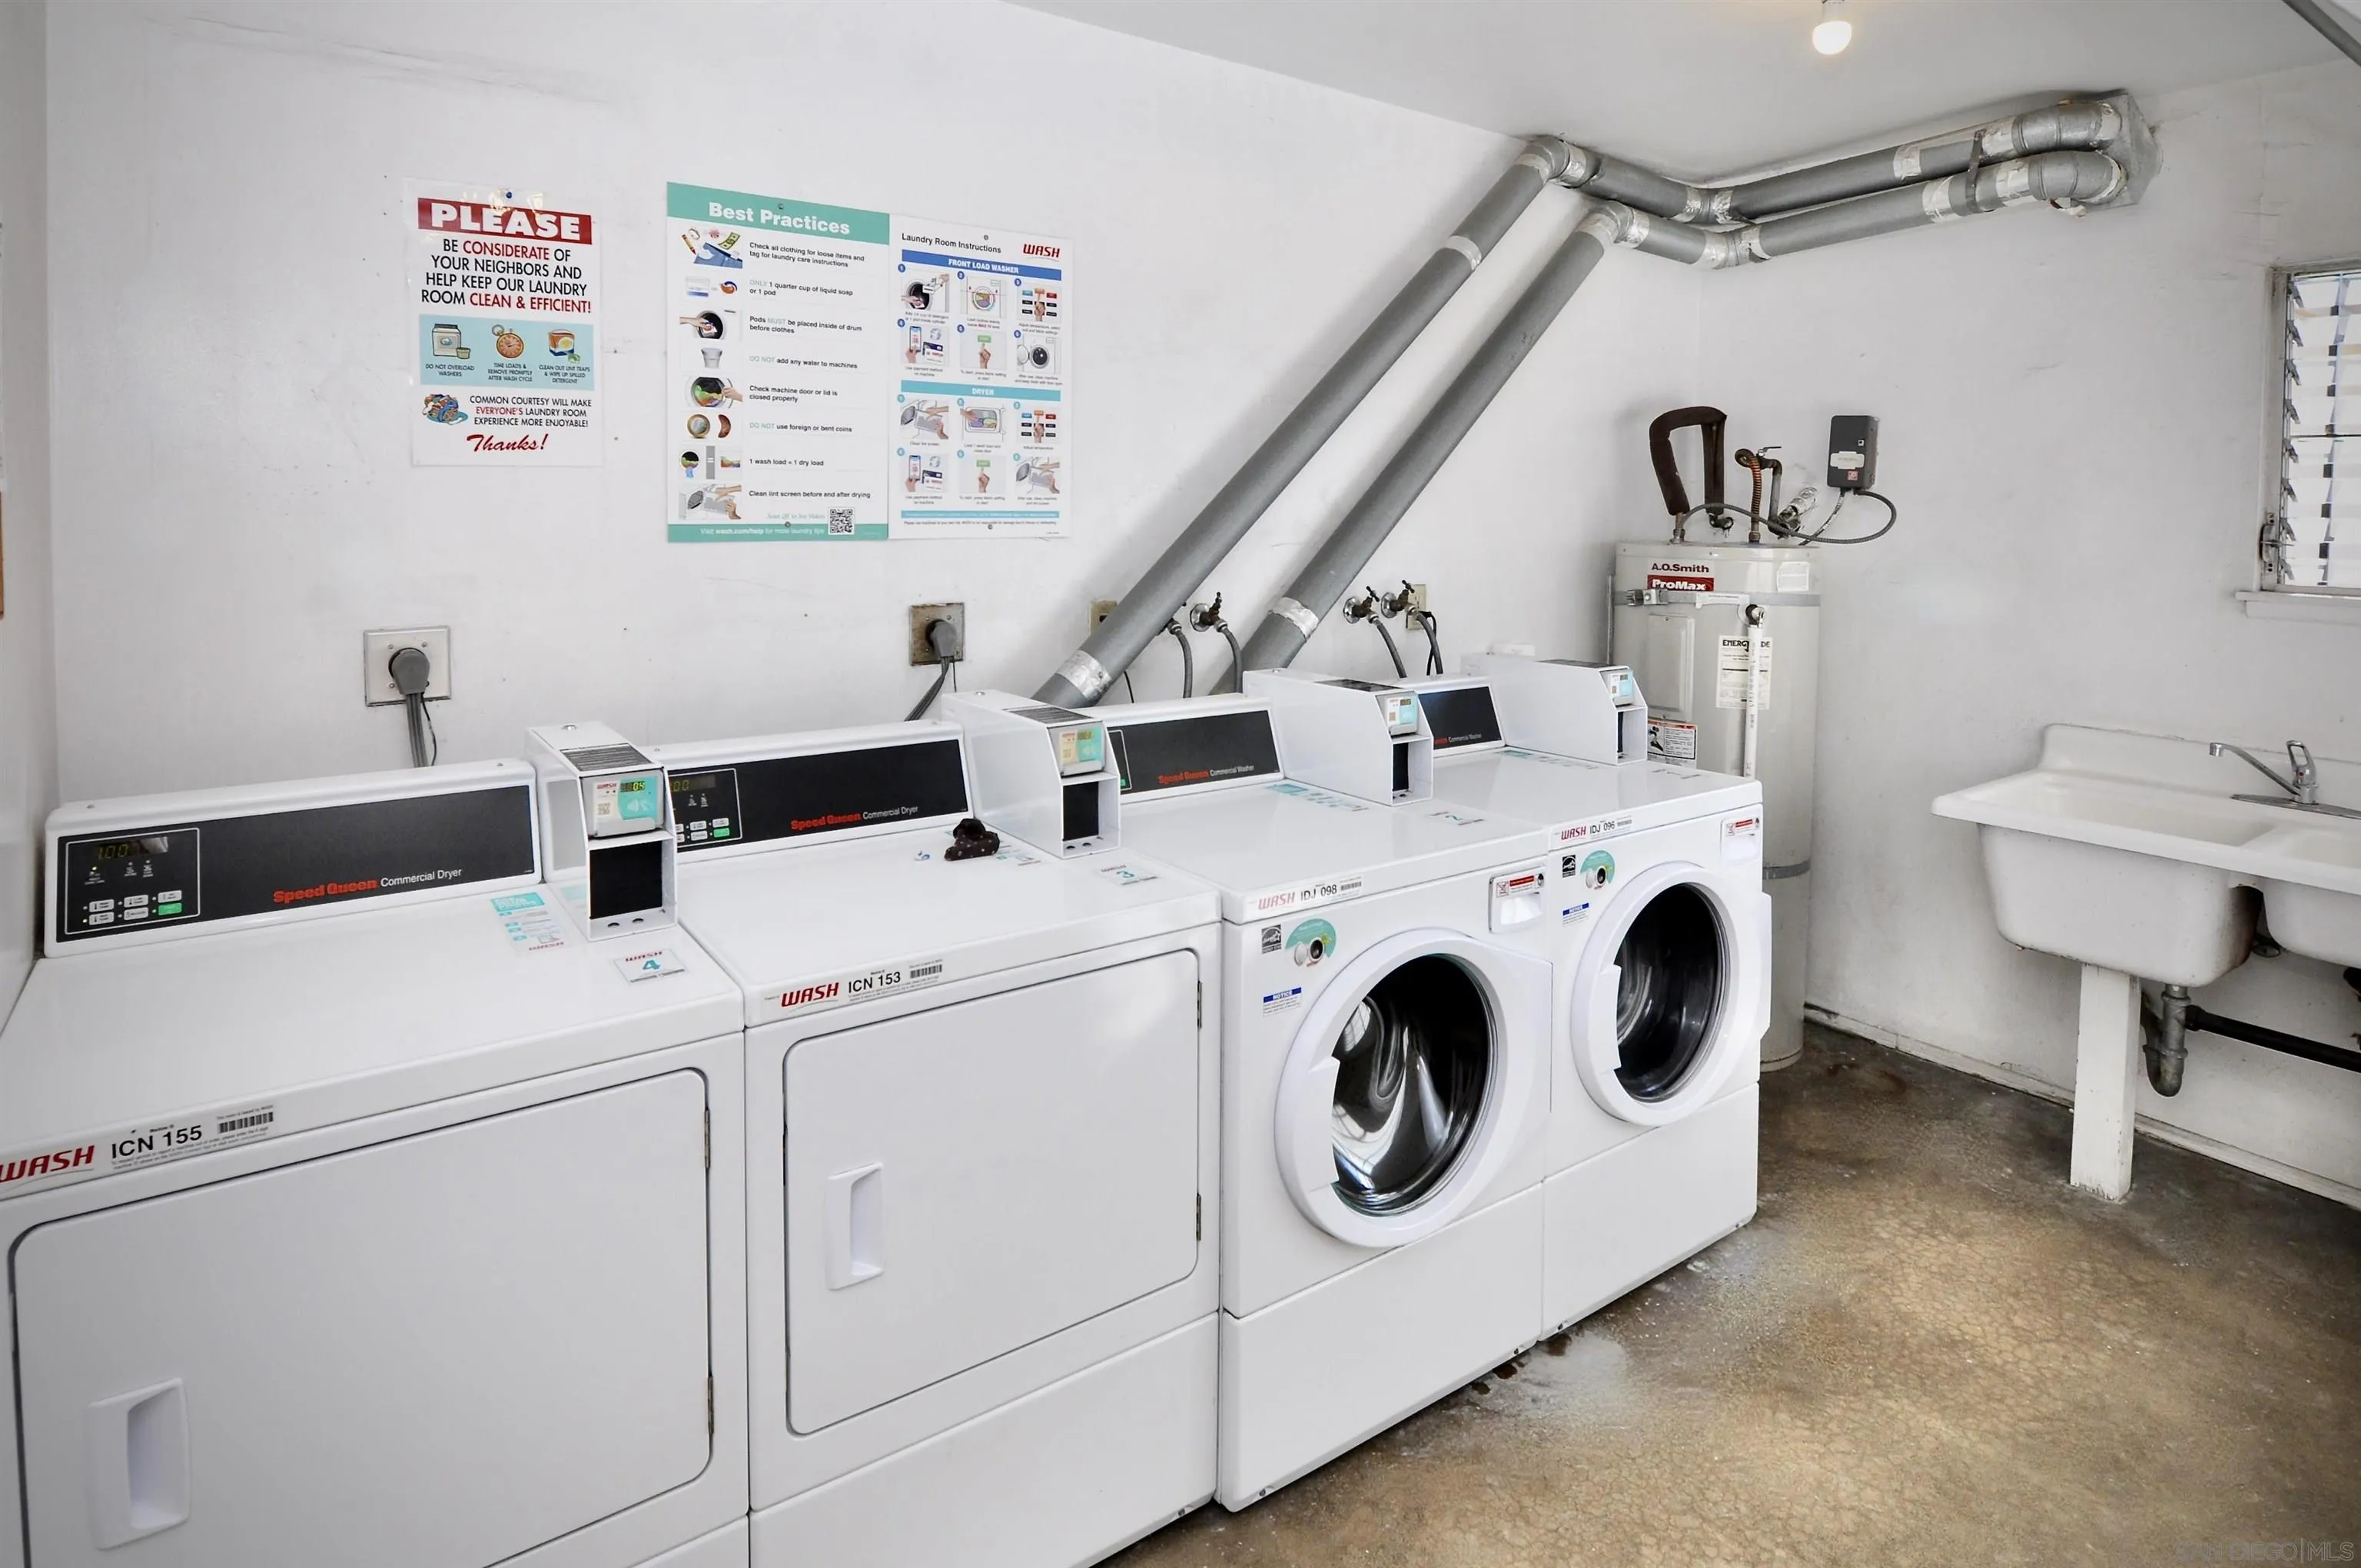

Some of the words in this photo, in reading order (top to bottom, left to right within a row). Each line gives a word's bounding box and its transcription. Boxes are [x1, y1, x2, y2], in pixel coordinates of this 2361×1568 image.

[430, 201, 580, 241] PLEASE
[709, 202, 754, 223] Best
[760, 208, 851, 235] Practices
[443, 239, 458, 253] BE
[463, 240, 550, 261] CONSIDERATE
[554, 249, 571, 261] OF
[749, 242, 769, 251] Check
[780, 246, 805, 255] clothing
[817, 250, 834, 258] loose
[835, 251, 852, 260] items
[902, 233, 932, 245] Laundry
[935, 238, 957, 247] Room
[958, 241, 1001, 254] Instructions
[1023, 244, 1060, 258] WASH
[431, 255, 470, 271] YOUR
[475, 257, 550, 277] NEIGHBORS
[553, 264, 582, 280] AND
[749, 251, 760, 260] tag
[772, 254, 795, 263] laundry
[812, 257, 848, 267] instructions
[948, 258, 971, 268] FRONT
[991, 264, 1019, 274] WASHER
[426, 272, 457, 287] HELP
[462, 275, 492, 290] KEEP
[496, 277, 524, 292] OUR
[529, 281, 587, 297] LAUNDRY
[775, 282, 797, 291] quarter
[820, 287, 837, 295] liquid
[421, 290, 465, 305] ROOM
[470, 293, 511, 308] CLEAN
[516, 296, 525, 308] &
[530, 298, 591, 314] EFFICIENT!
[797, 320, 817, 329] placed
[772, 395, 798, 404] properly
[971, 387, 995, 396] DRYER
[470, 396, 509, 404] COMMON
[512, 397, 549, 406] COURTESY
[476, 407, 523, 415] EVERYONE'S
[474, 417, 519, 426] EXPERIENCE
[546, 419, 588, 427] ENJOYABLE!
[467, 434, 549, 452] Thanks!
[1652, 563, 1709, 573] A.O.Smith
[1652, 579, 1706, 591] ProMax
[790, 816, 825, 831] Speed
[827, 812, 861, 824] Queen
[863, 807, 900, 819] Commercial
[901, 806, 918, 816] Dryer
[1560, 826, 1587, 841] WASH
[1589, 824, 1601, 835] IDJ
[273, 885, 325, 904] Speed
[327, 879, 378, 894] Queen
[380, 871, 435, 887] Commercial
[437, 869, 462, 880] Dryer
[1258, 891, 1296, 911] WASH
[1300, 888, 1317, 902] IDJ
[1320, 884, 1337, 896] 098
[781, 982, 839, 1008] WASH
[848, 977, 873, 993] ICN
[878, 971, 902, 987] 153
[111, 1134, 154, 1159] ICN
[162, 1125, 203, 1147] 155
